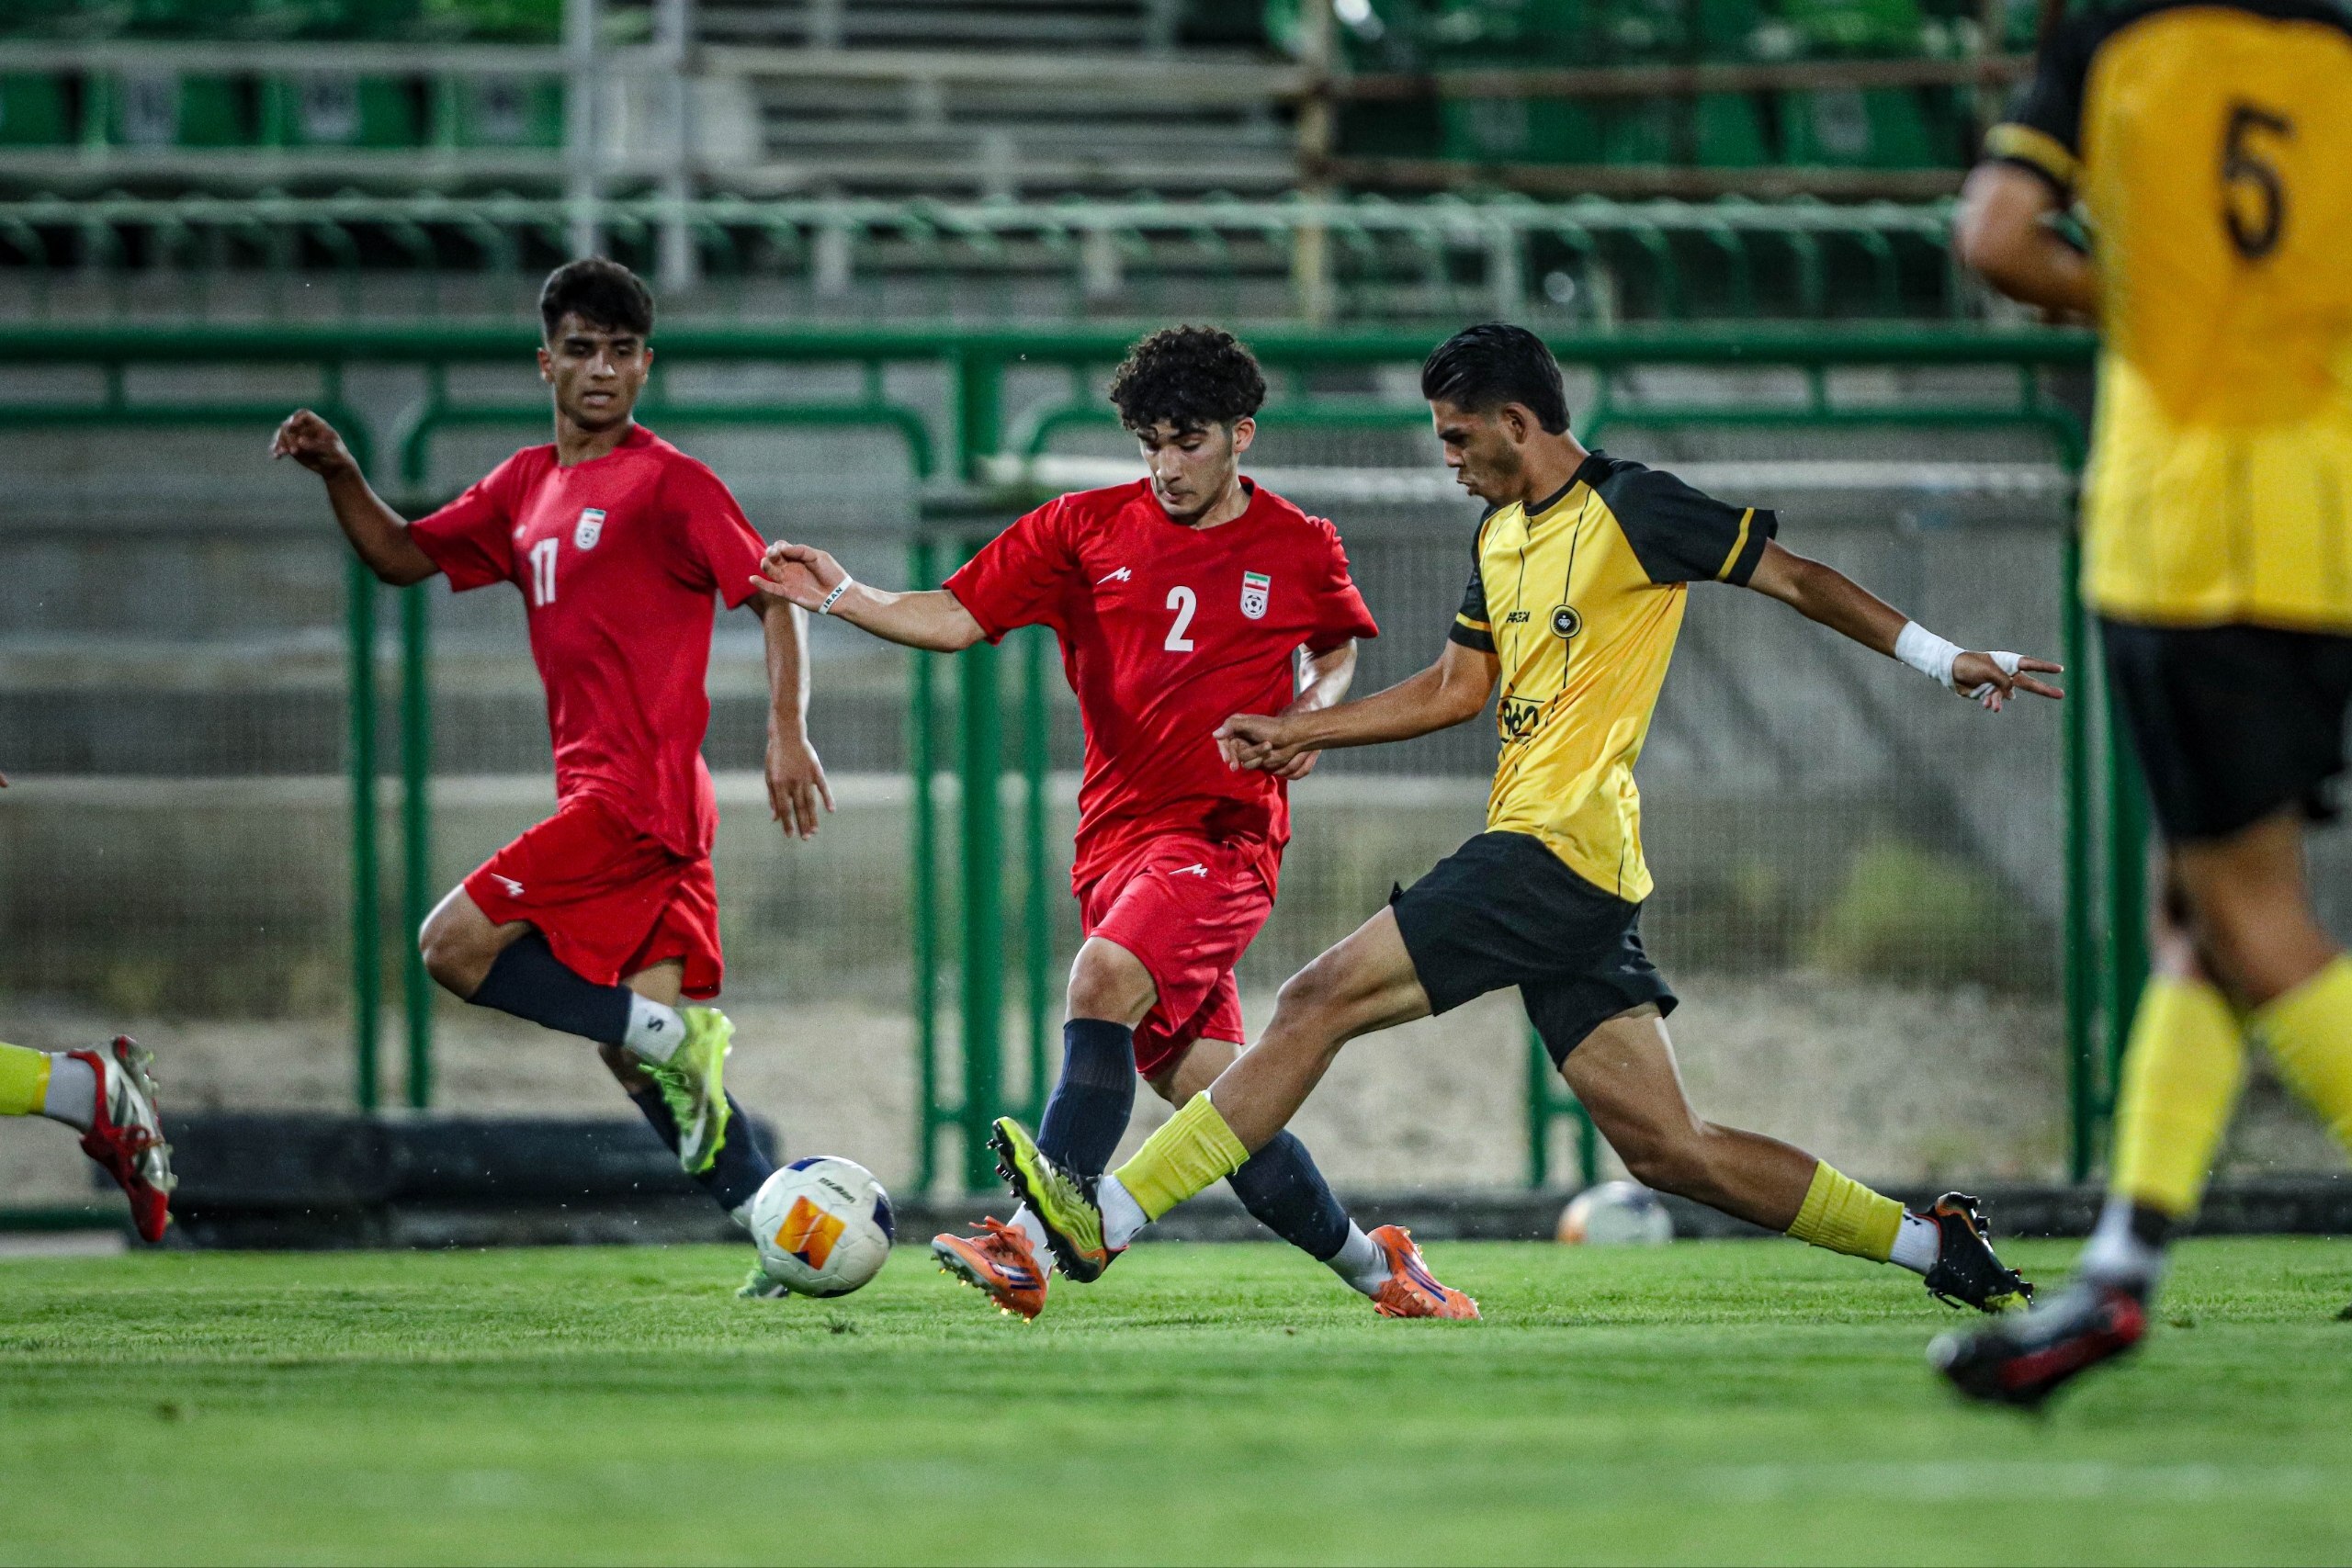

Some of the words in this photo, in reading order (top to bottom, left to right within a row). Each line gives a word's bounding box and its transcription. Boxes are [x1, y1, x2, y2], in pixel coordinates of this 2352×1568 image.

[2222, 104, 2296, 260] 5
[823, 586, 842, 608] IRAN
[1164, 585, 1197, 652] 2
